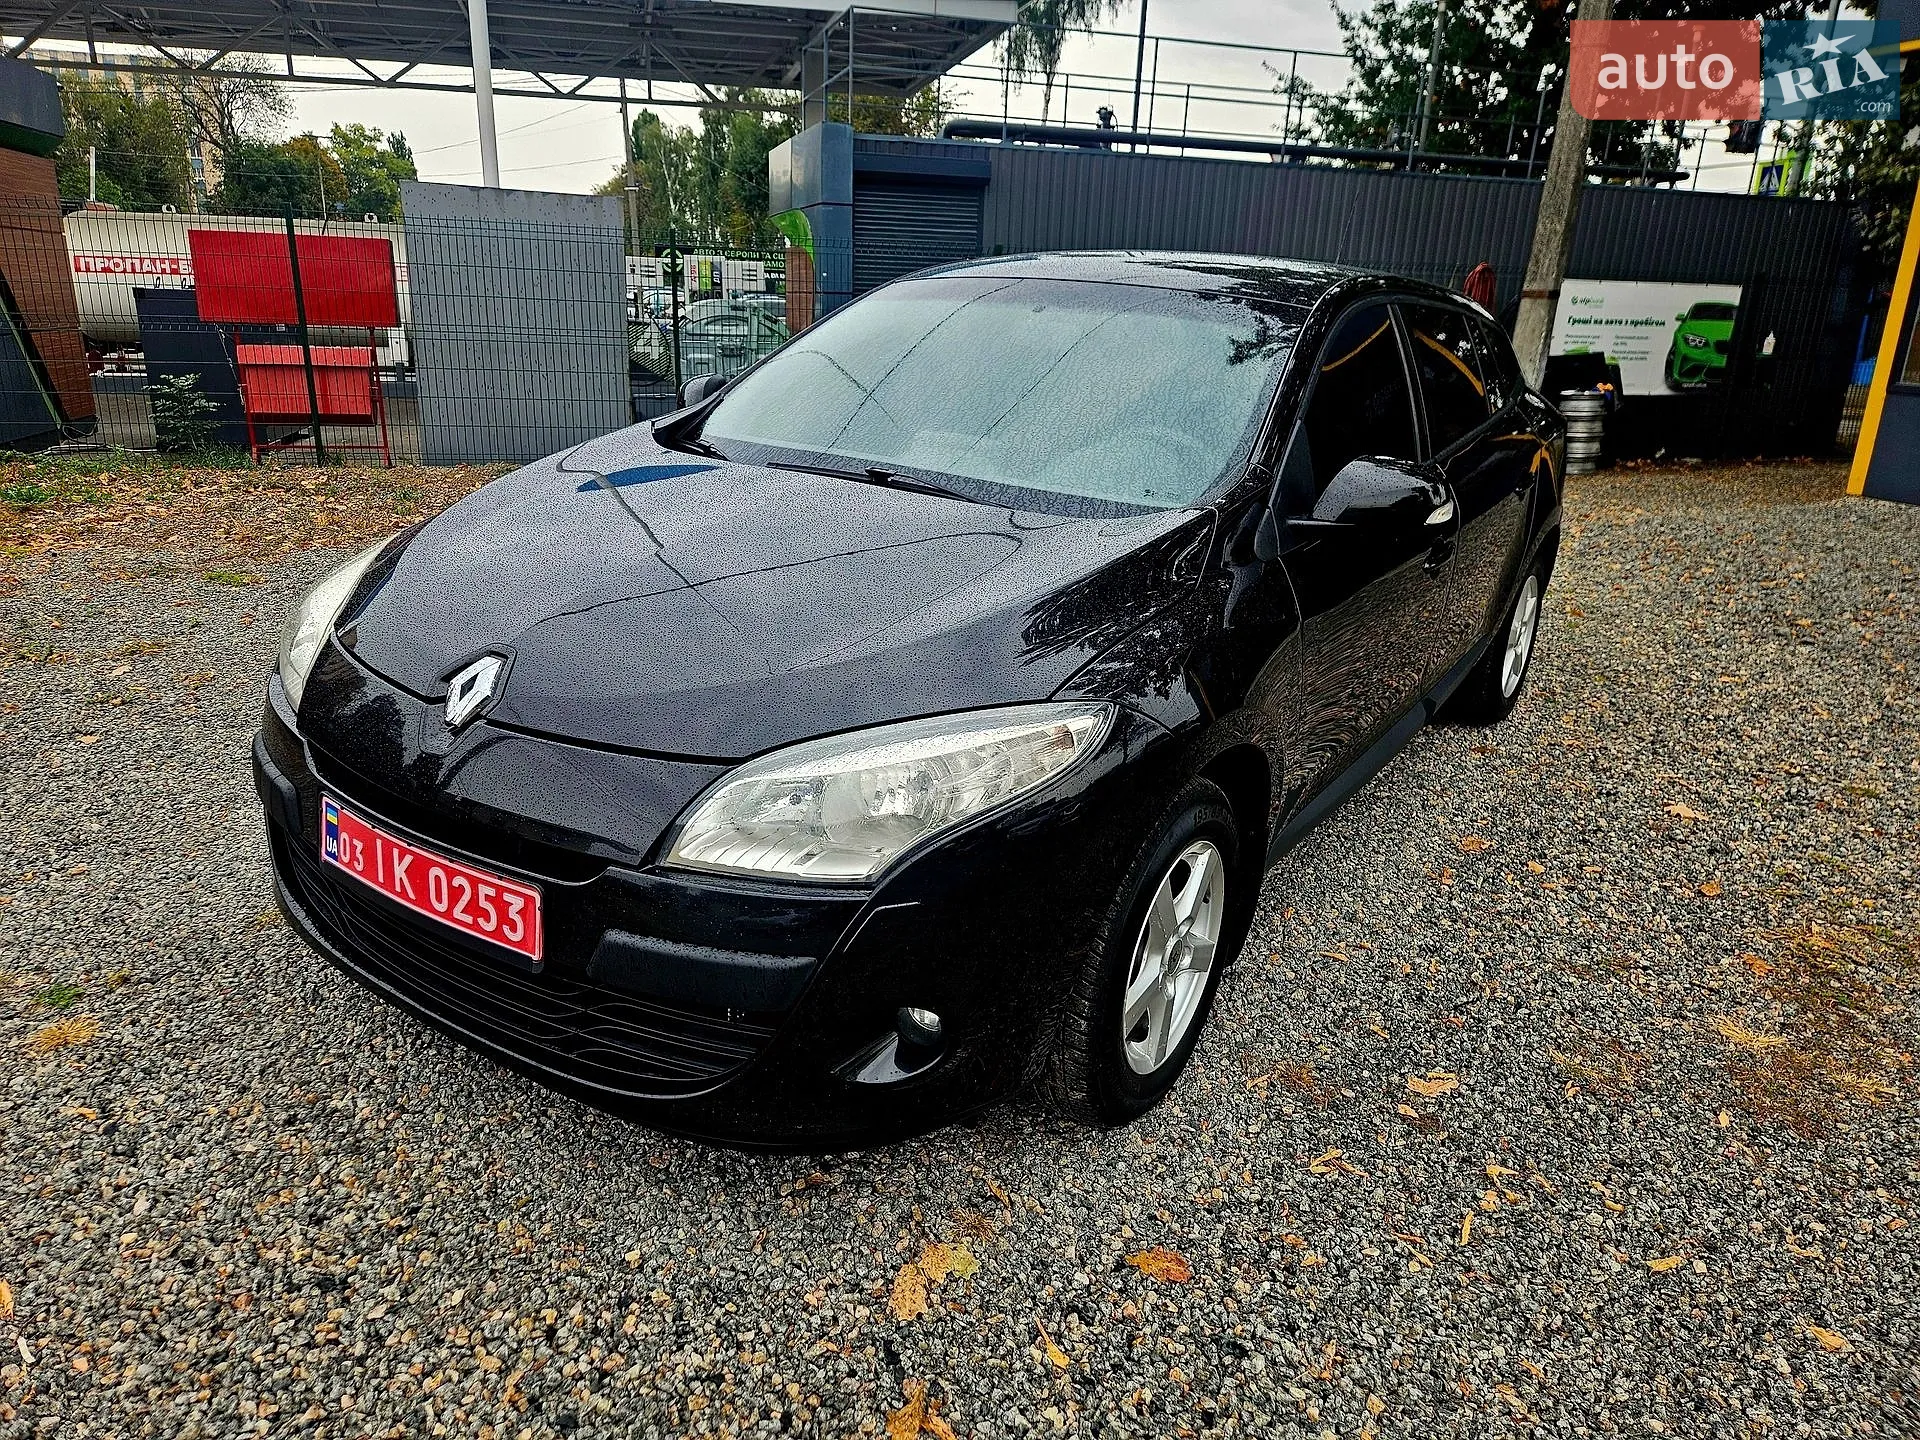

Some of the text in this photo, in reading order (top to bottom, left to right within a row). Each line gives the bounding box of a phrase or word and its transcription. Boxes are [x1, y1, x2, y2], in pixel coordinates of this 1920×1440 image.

[78, 256, 194, 275] ПРОПАН-Б
[1567, 315, 1593, 326] Гроші
[326, 835, 338, 856] UA
[339, 831, 525, 942] 03 IK 0253
